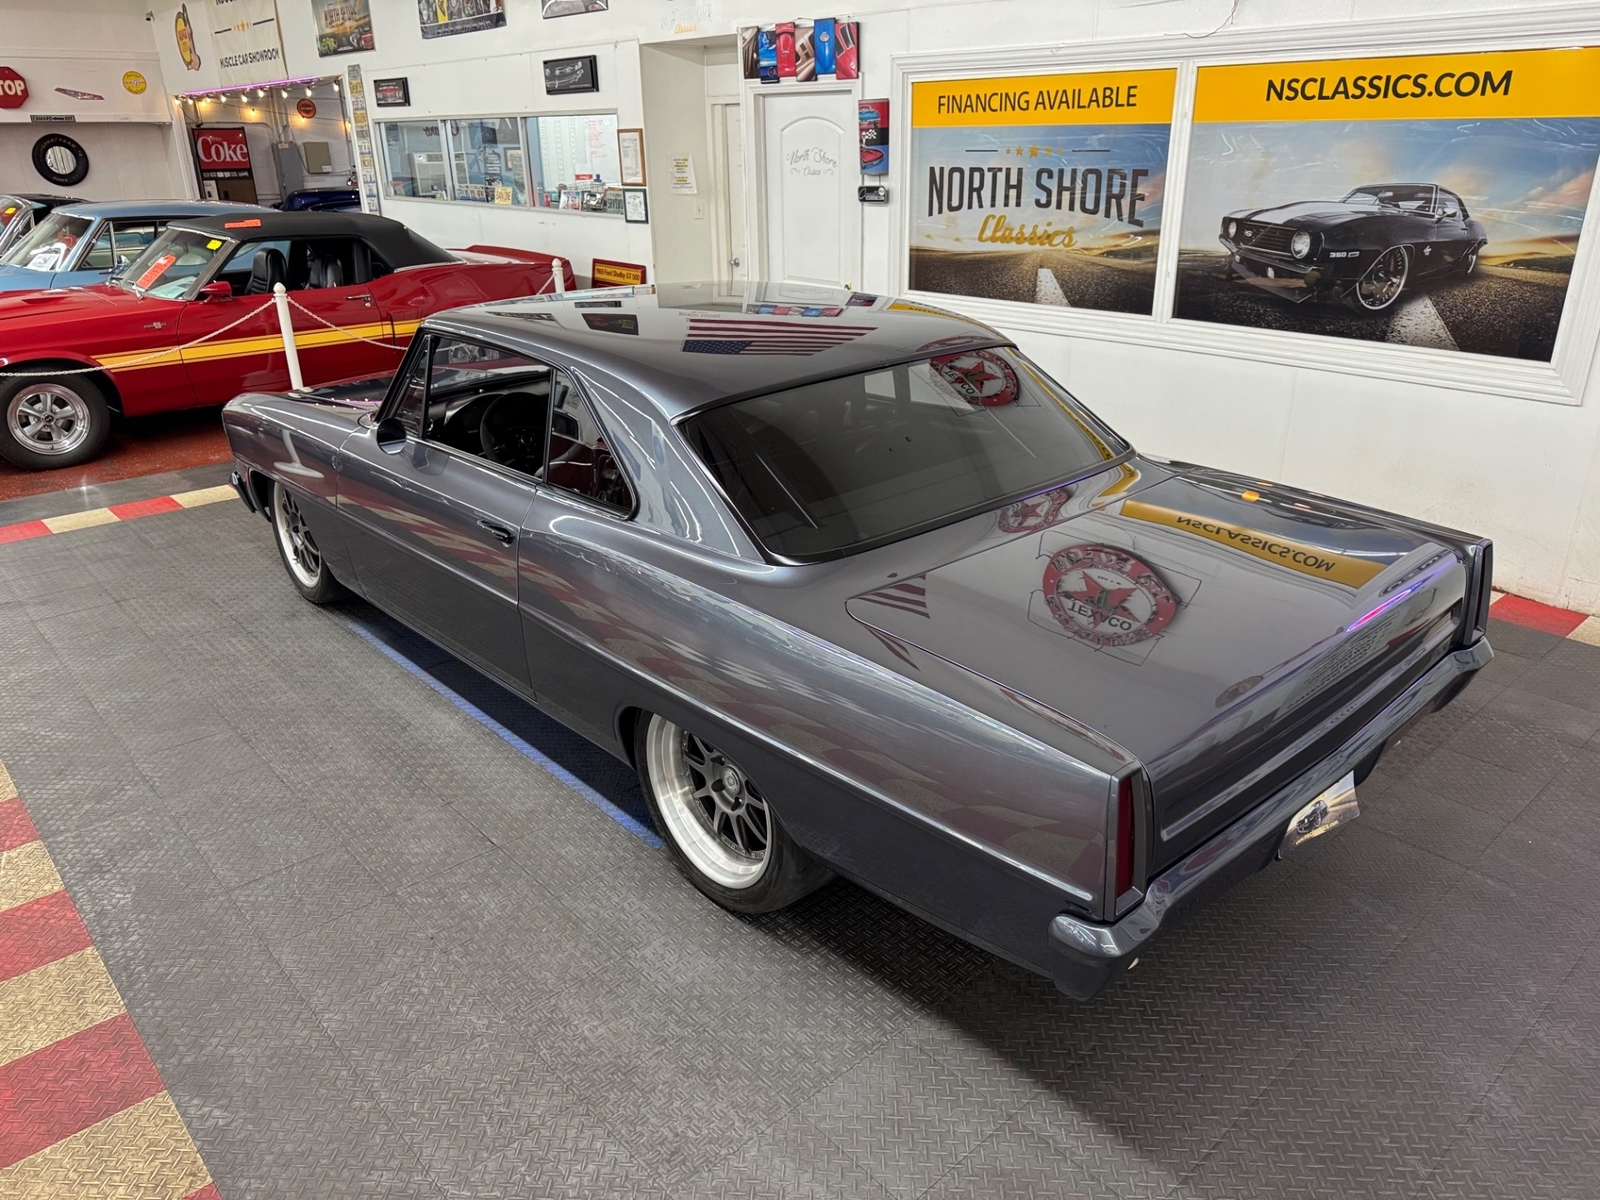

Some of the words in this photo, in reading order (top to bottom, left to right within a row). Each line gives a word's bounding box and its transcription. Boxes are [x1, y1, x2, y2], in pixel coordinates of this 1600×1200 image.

[220, 55, 239, 69] MUSCLE
[239, 53, 249, 65] CAR
[249, 47, 280, 63] SHOWROOM
[0, 79, 26, 96] TOP
[937, 89, 1033, 115] FINANCING
[1034, 84, 1138, 112] AVAILABLE
[1265, 70, 1513, 103] NSCLASSICS.COM
[197, 136, 248, 162] Coke
[786, 149, 811, 166] North
[812, 147, 838, 168] Shore
[927, 164, 1026, 219] NORTH
[1034, 167, 1149, 230] SHORE
[977, 212, 1078, 250] Classics
[604, 269, 613, 277] Ford
[613, 270, 626, 280] Shelby
